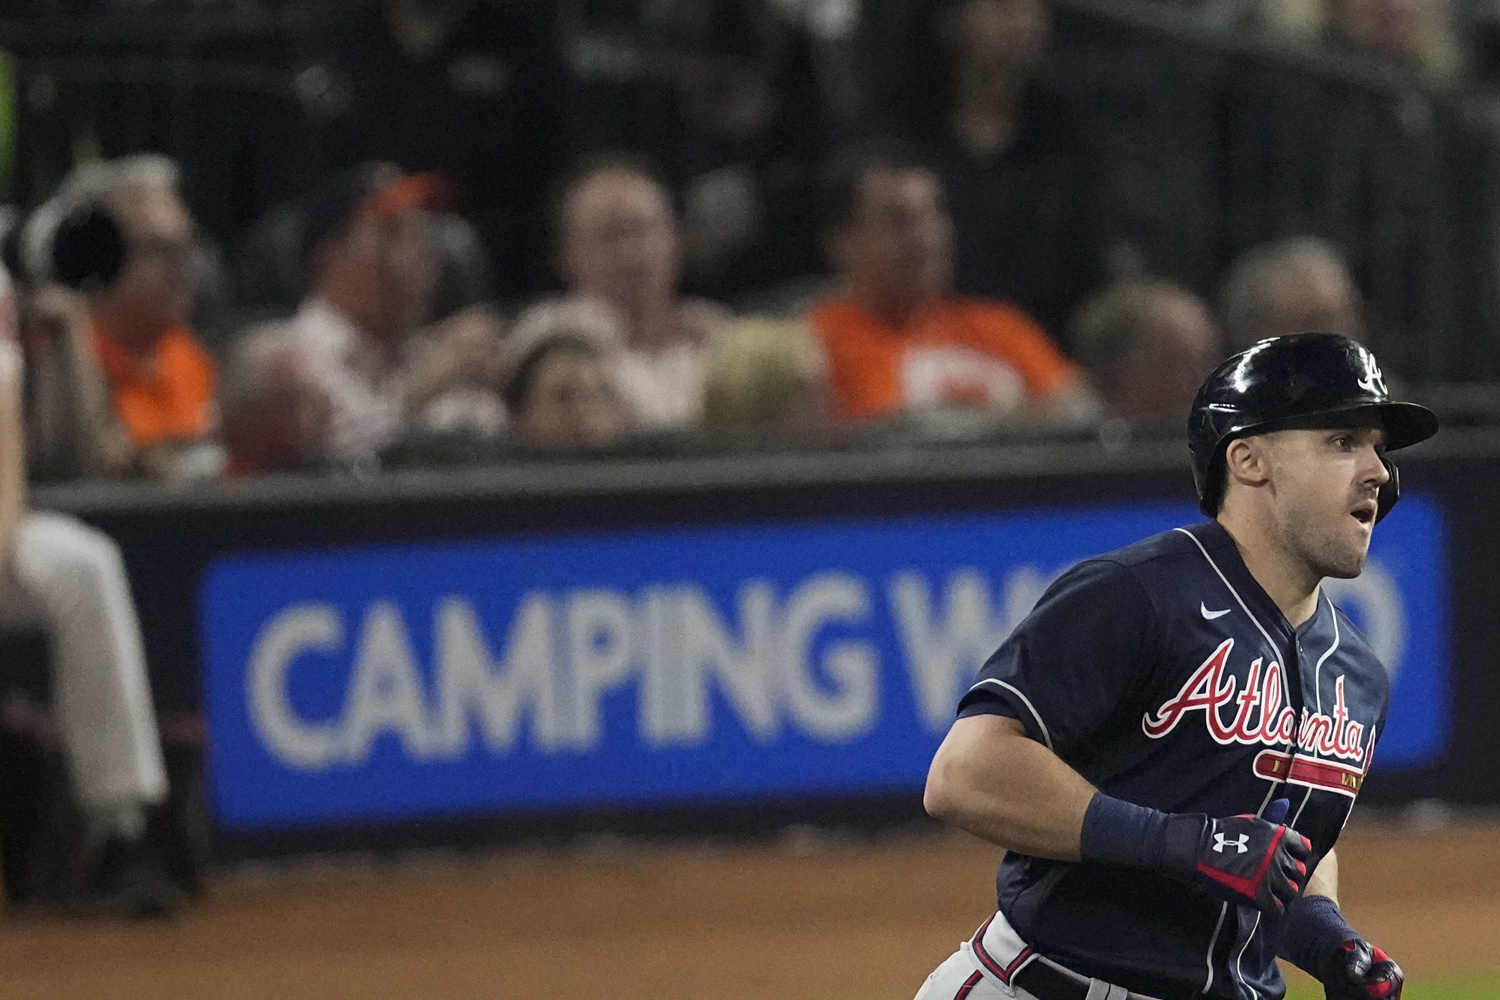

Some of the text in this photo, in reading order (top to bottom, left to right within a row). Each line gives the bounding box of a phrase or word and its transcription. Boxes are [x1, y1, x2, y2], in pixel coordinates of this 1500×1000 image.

[1357, 352, 1389, 396] A
[247, 573, 880, 768] CAMPING
[1142, 637, 1365, 762] Atlanta
